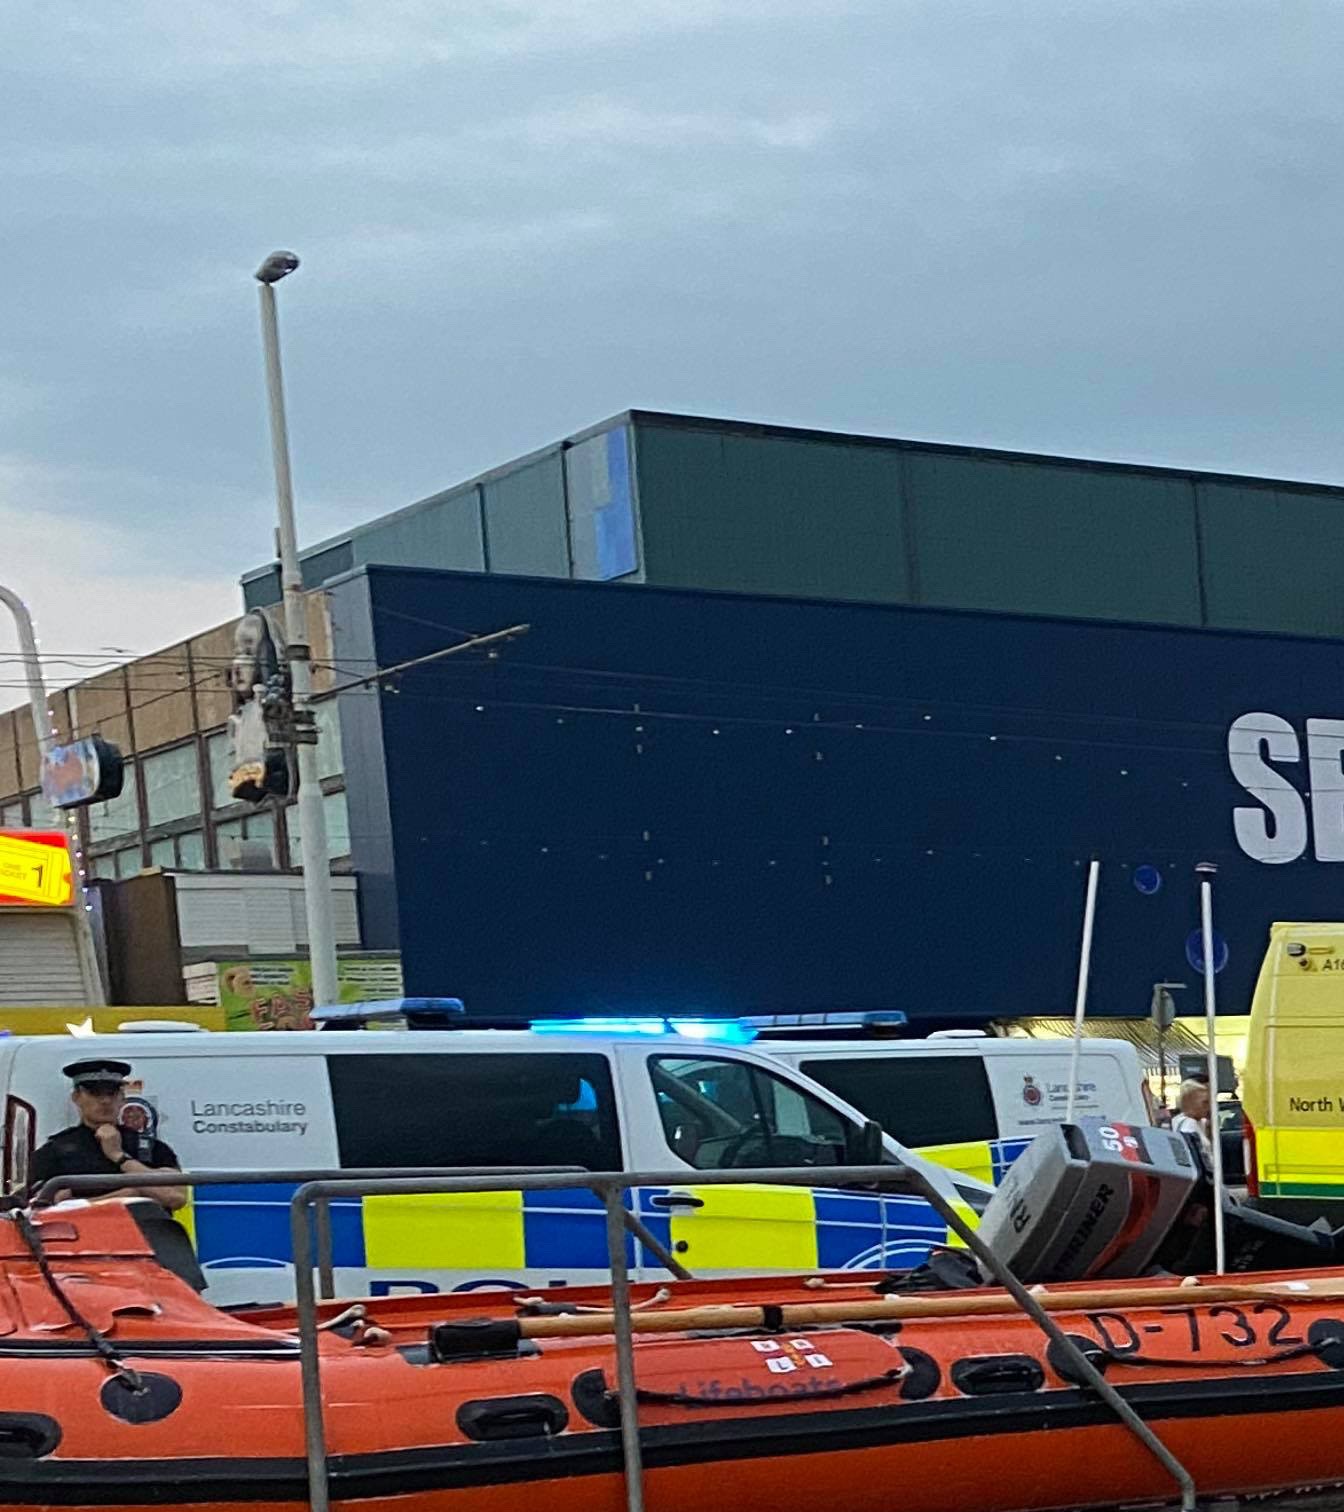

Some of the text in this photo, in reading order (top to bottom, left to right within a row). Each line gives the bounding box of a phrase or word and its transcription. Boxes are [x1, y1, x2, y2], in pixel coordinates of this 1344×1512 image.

[190, 1100, 306, 1117] Lancashire
[1289, 1097, 1333, 1113] North
[192, 1120, 308, 1136] Constabulary
[1086, 1302, 1304, 1355] D-732
